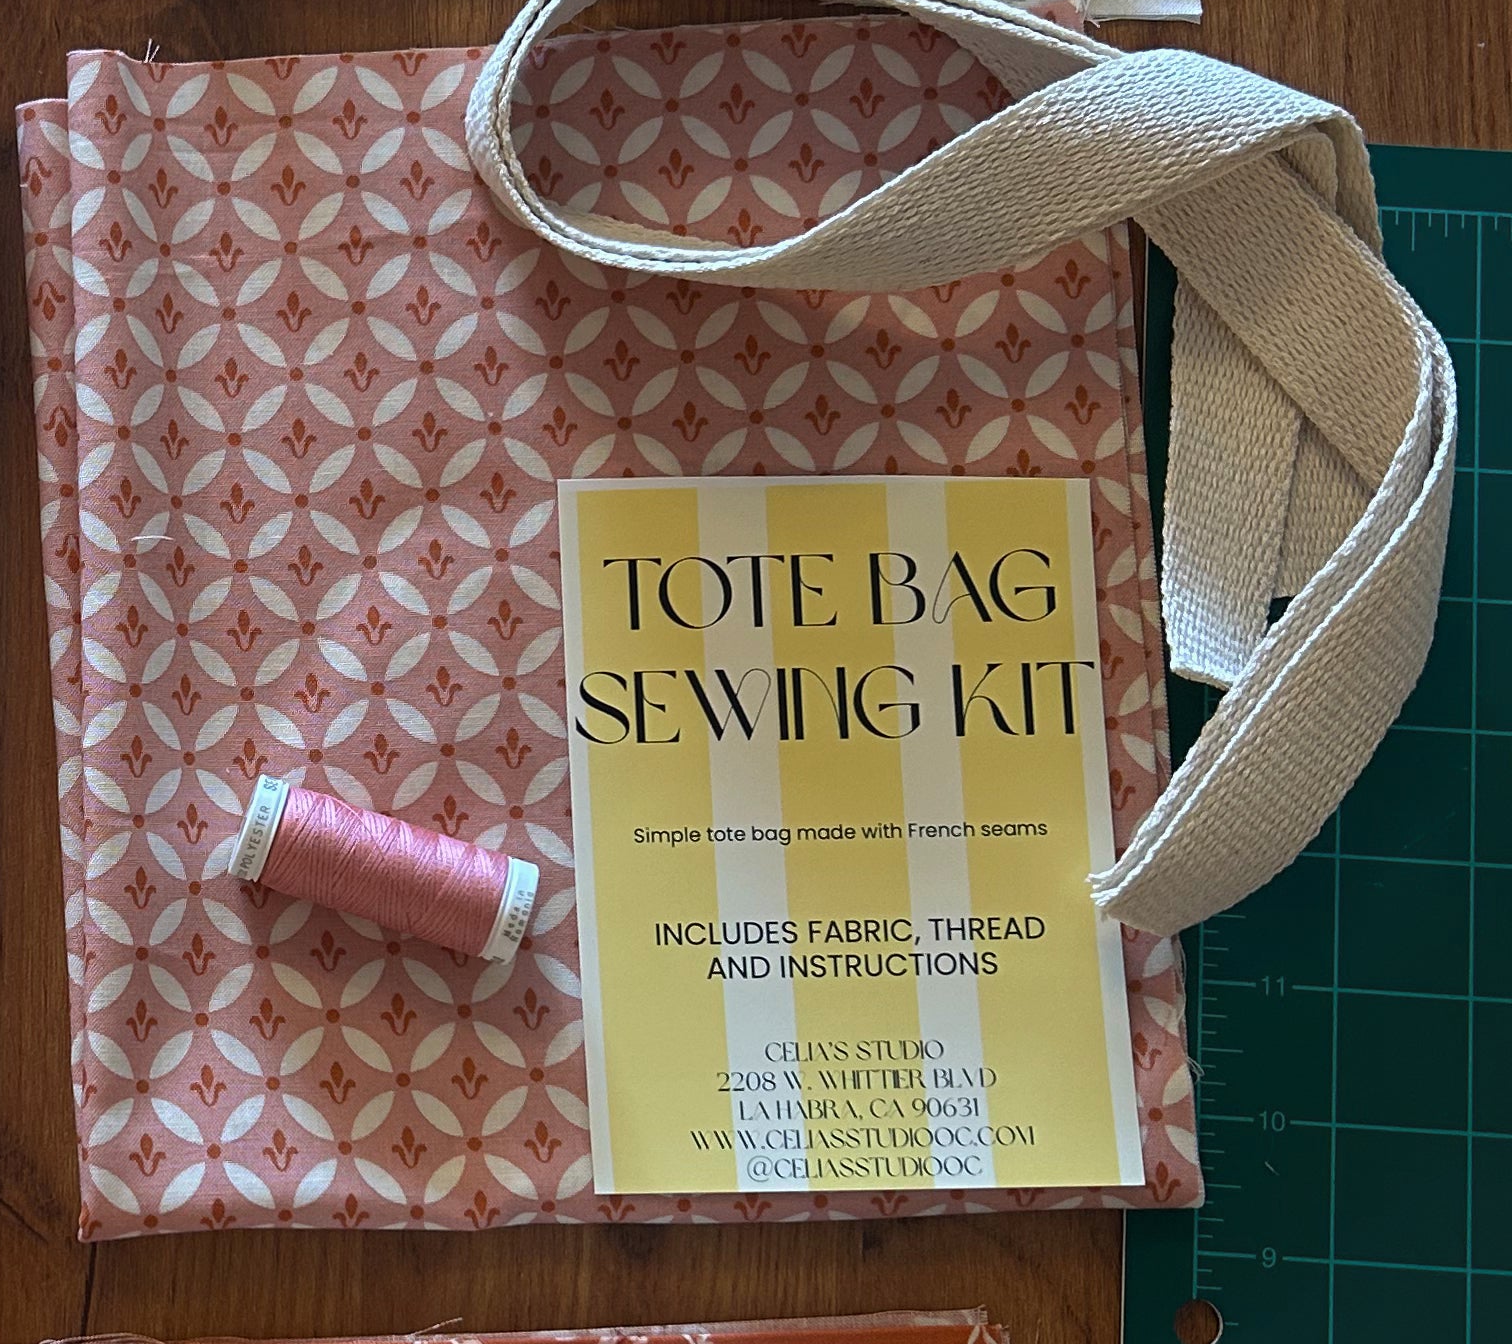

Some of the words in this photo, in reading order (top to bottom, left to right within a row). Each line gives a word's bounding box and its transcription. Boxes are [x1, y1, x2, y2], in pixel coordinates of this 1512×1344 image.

[602, 553, 838, 631] TOTE
[868, 548, 1057, 626] BAG
[574, 665, 921, 745] SEWING
[951, 660, 1096, 738] KIT
[239, 804, 272, 870] POLYESTER
[633, 826, 702, 848] Simple
[705, 826, 747, 843] tote
[751, 825, 792, 846] bag
[796, 823, 857, 841] made
[860, 822, 903, 840] with
[907, 821, 976, 838] French
[980, 823, 1048, 837] seams
[655, 920, 799, 946] INCLUDES
[807, 918, 921, 947] FABRIC,
[927, 916, 1046, 942] THREAD
[707, 955, 771, 980] AND
[779, 951, 998, 979] INSTRUCTIONS
[1261, 975, 1285, 996] 11
[764, 1041, 850, 1063] CELIA'S
[855, 1039, 945, 1062] STUDIO
[716, 1071, 777, 1093] 2208
[783, 1070, 813, 1091] W.
[817, 1068, 927, 1091] WHITTIER
[932, 1067, 997, 1089] BLVD
[739, 1100, 771, 1121] LA
[775, 1098, 864, 1121] HABRA,
[869, 1097, 905, 1120] CA
[911, 1096, 980, 1119] 90631
[1259, 1110, 1286, 1132] 10
[690, 1125, 1035, 1151] WWW.CELIASSTUDIOOC.COM
[746, 1154, 983, 1183] @CELIASSTUDIOOC
[1261, 1246, 1277, 1269] 9
